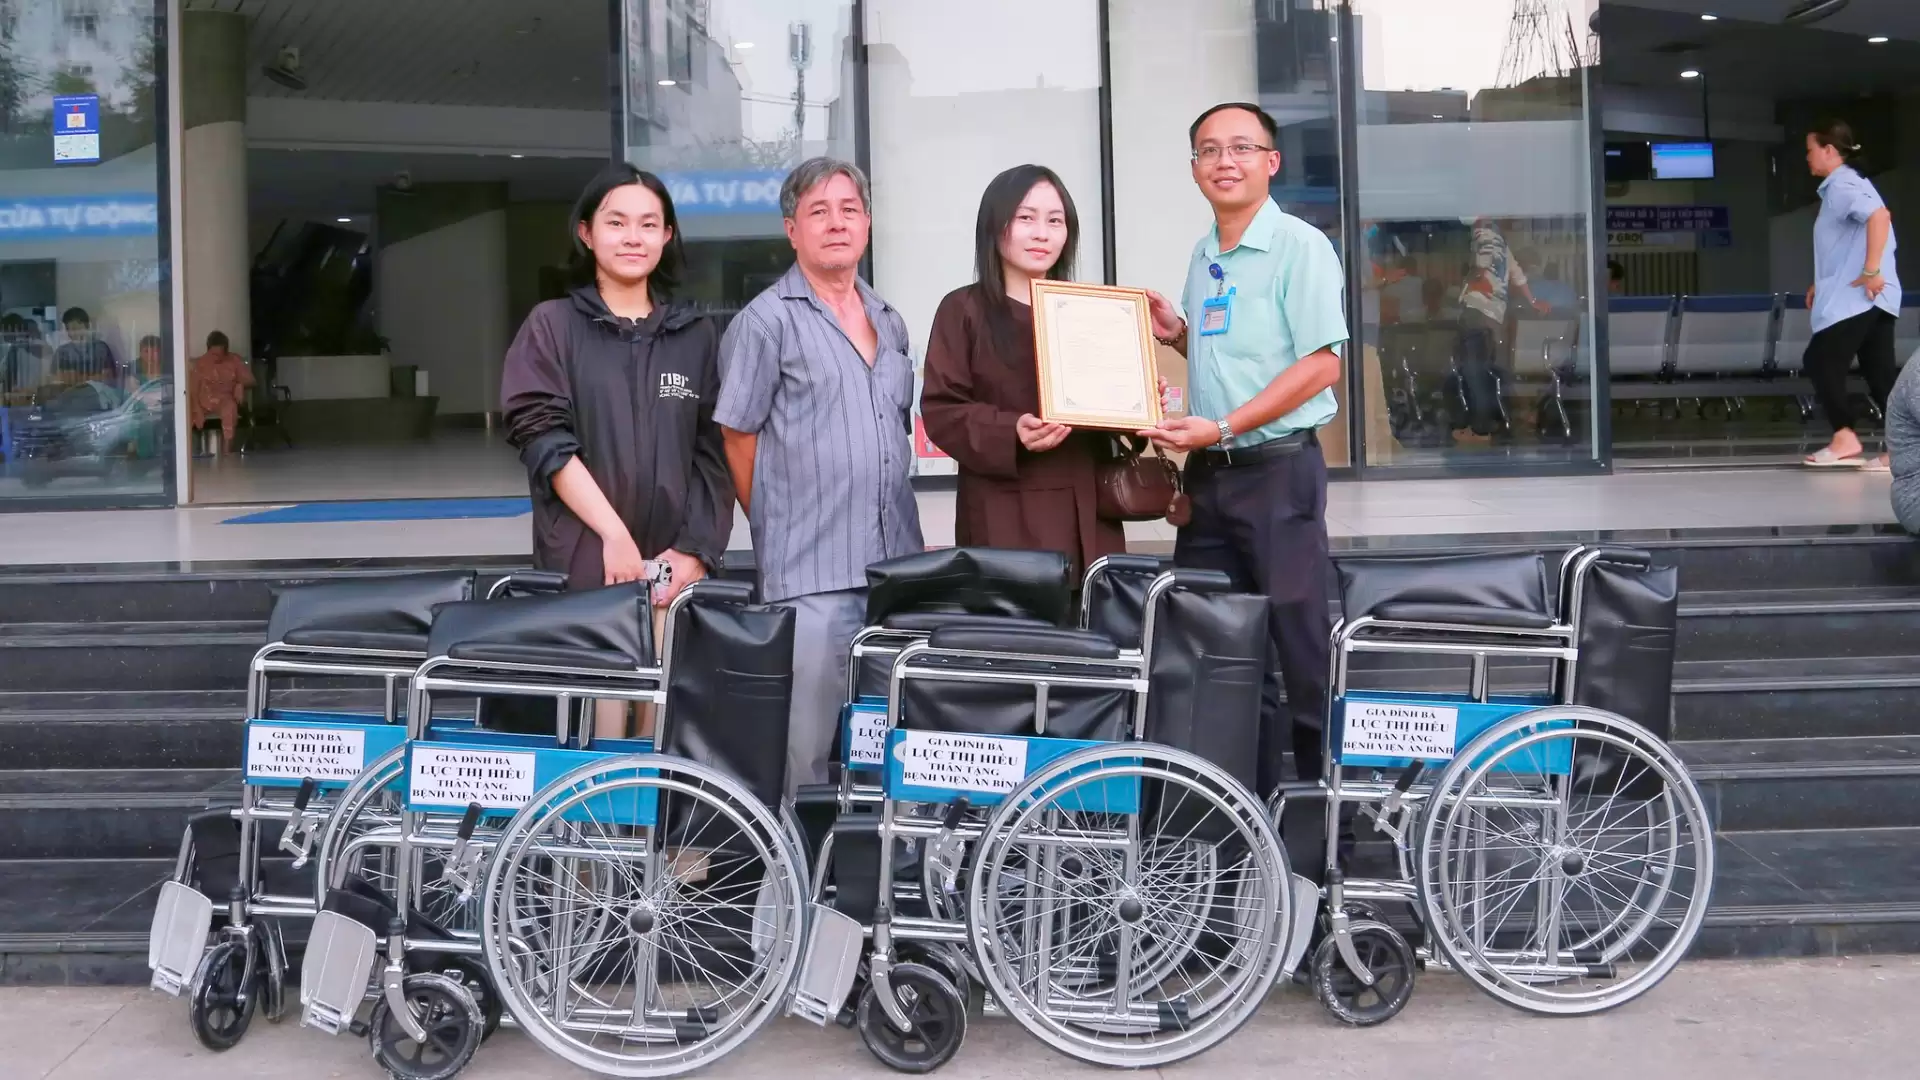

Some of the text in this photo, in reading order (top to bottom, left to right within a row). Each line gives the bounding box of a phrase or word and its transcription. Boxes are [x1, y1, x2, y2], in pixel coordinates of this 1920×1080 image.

[743, 178, 781, 206] ĐỘ
[1366, 708, 1436, 719] GIA ĐÌNH BÀ
[873, 718, 887, 726] GI
[1352, 719, 1380, 730] LỤC
[1385, 721, 1409, 732] THỊ
[272, 732, 342, 742] GIA ĐÌNH BÀ
[859, 728, 885, 739] LỤC
[1367, 731, 1397, 740] THÂN
[258, 742, 287, 753] LỤC
[292, 743, 316, 755] THỊ
[928, 738, 1004, 751] GIA ĐÌNH BÀ
[275, 753, 305, 763] THÂN
[436, 755, 511, 765] GIA ĐÌNH BÀ
[851, 749, 881, 760] BỆNH
[912, 748, 944, 760] LỤC
[948, 751, 975, 764] THỊ
[420, 765, 452, 777] LỤC
[456, 767, 483, 780] THỊ
[929, 762, 962, 772] THÂN
[437, 778, 471, 788] THÂN
